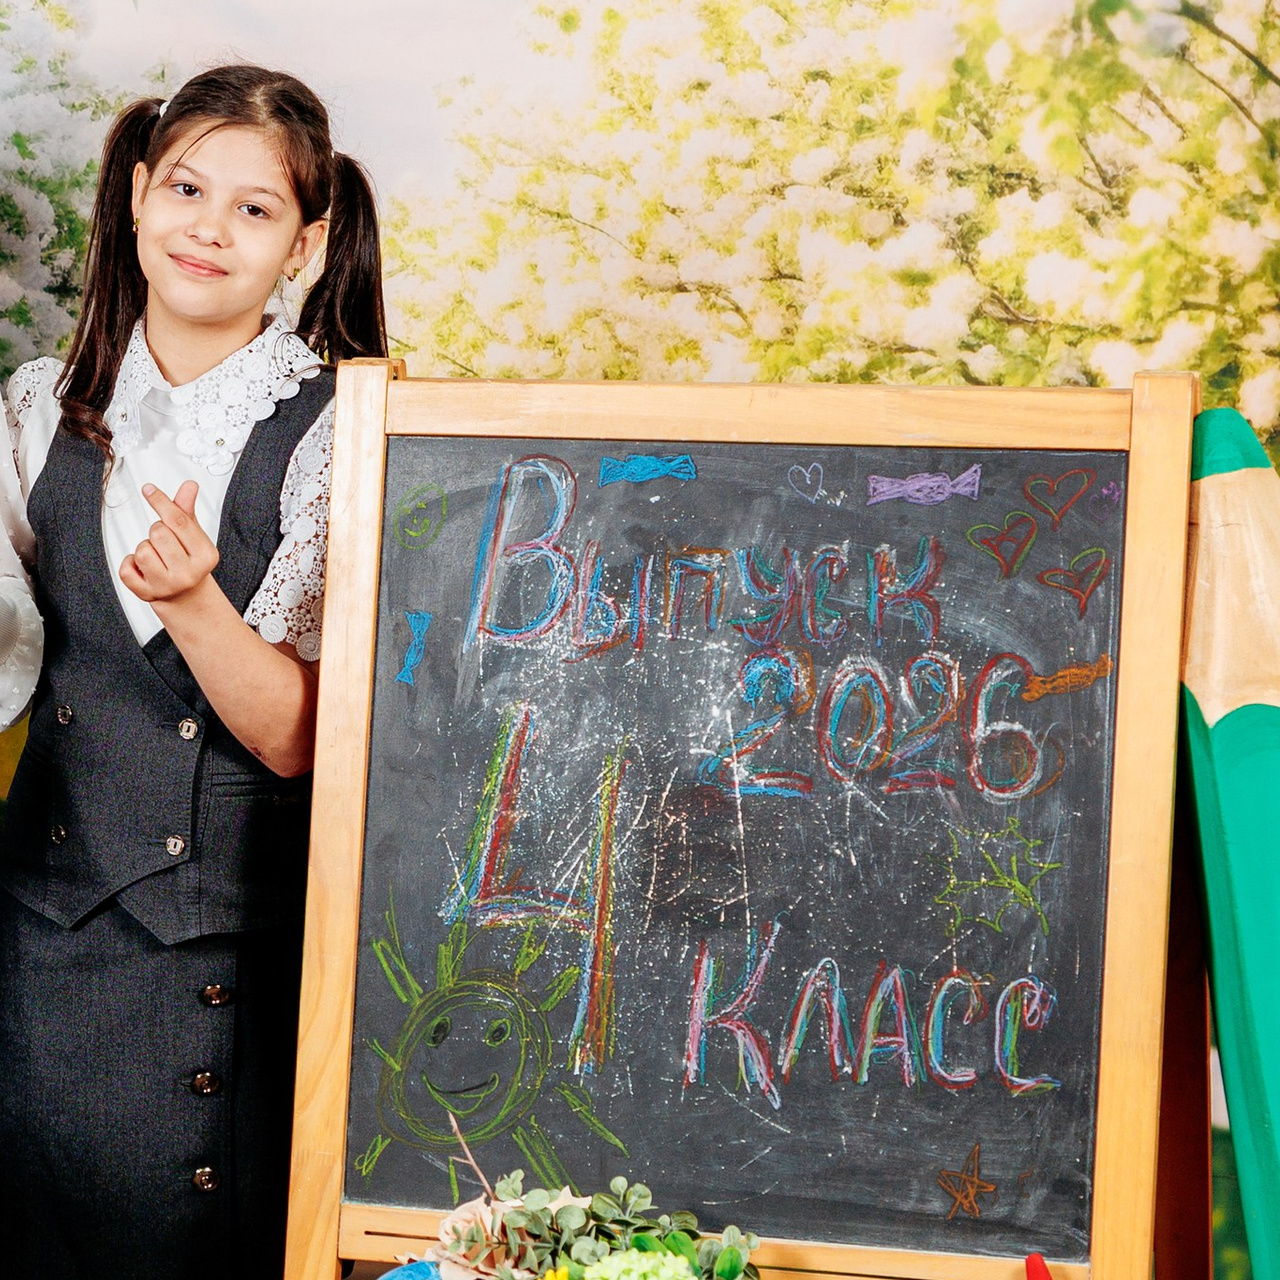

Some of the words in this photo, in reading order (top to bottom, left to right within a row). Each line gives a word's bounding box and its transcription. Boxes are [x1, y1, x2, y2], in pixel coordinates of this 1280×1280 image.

[464, 455, 942, 662] Выпуск
[700, 652, 1062, 803] 2026
[442, 702, 626, 1074] 4
